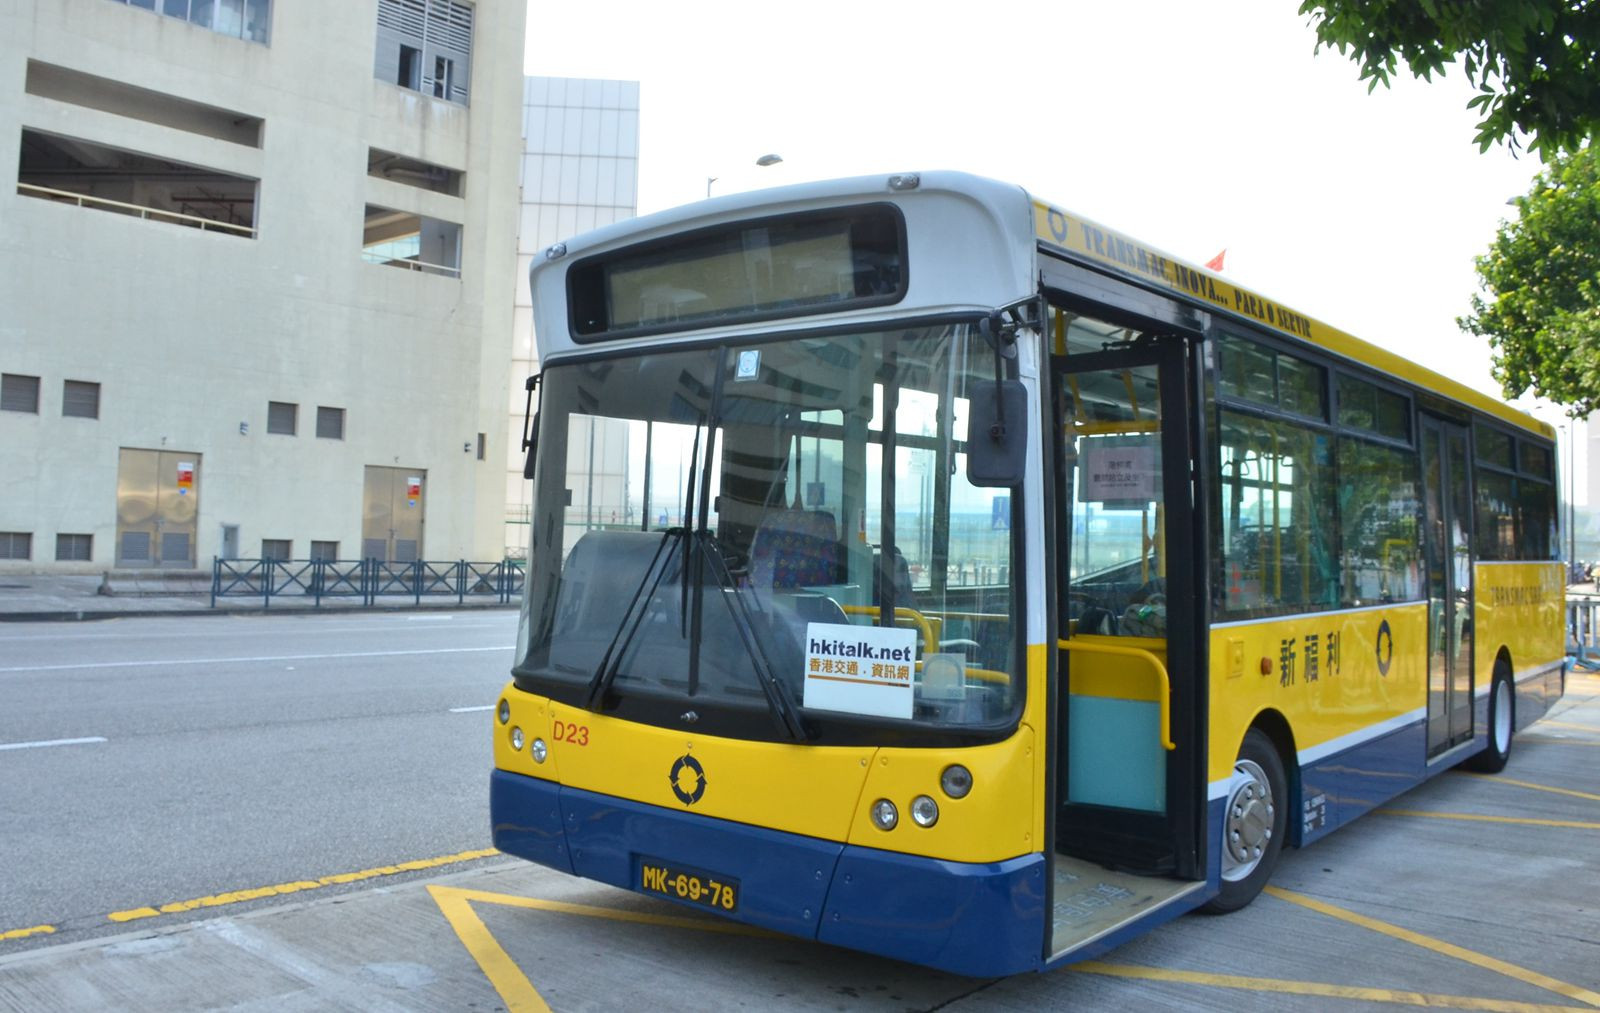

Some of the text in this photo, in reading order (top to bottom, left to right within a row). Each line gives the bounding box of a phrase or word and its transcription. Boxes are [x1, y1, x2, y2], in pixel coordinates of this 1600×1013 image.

[1234, 288, 1265, 319] PARA
[1266, 302, 1275, 324] O
[1277, 307, 1312, 338] SERVIR
[810, 638, 911, 662] hkitalk.net
[1280, 630, 1340, 688] 新福利
[553, 721, 589, 746] D23
[643, 866, 735, 909] MK-69-78
